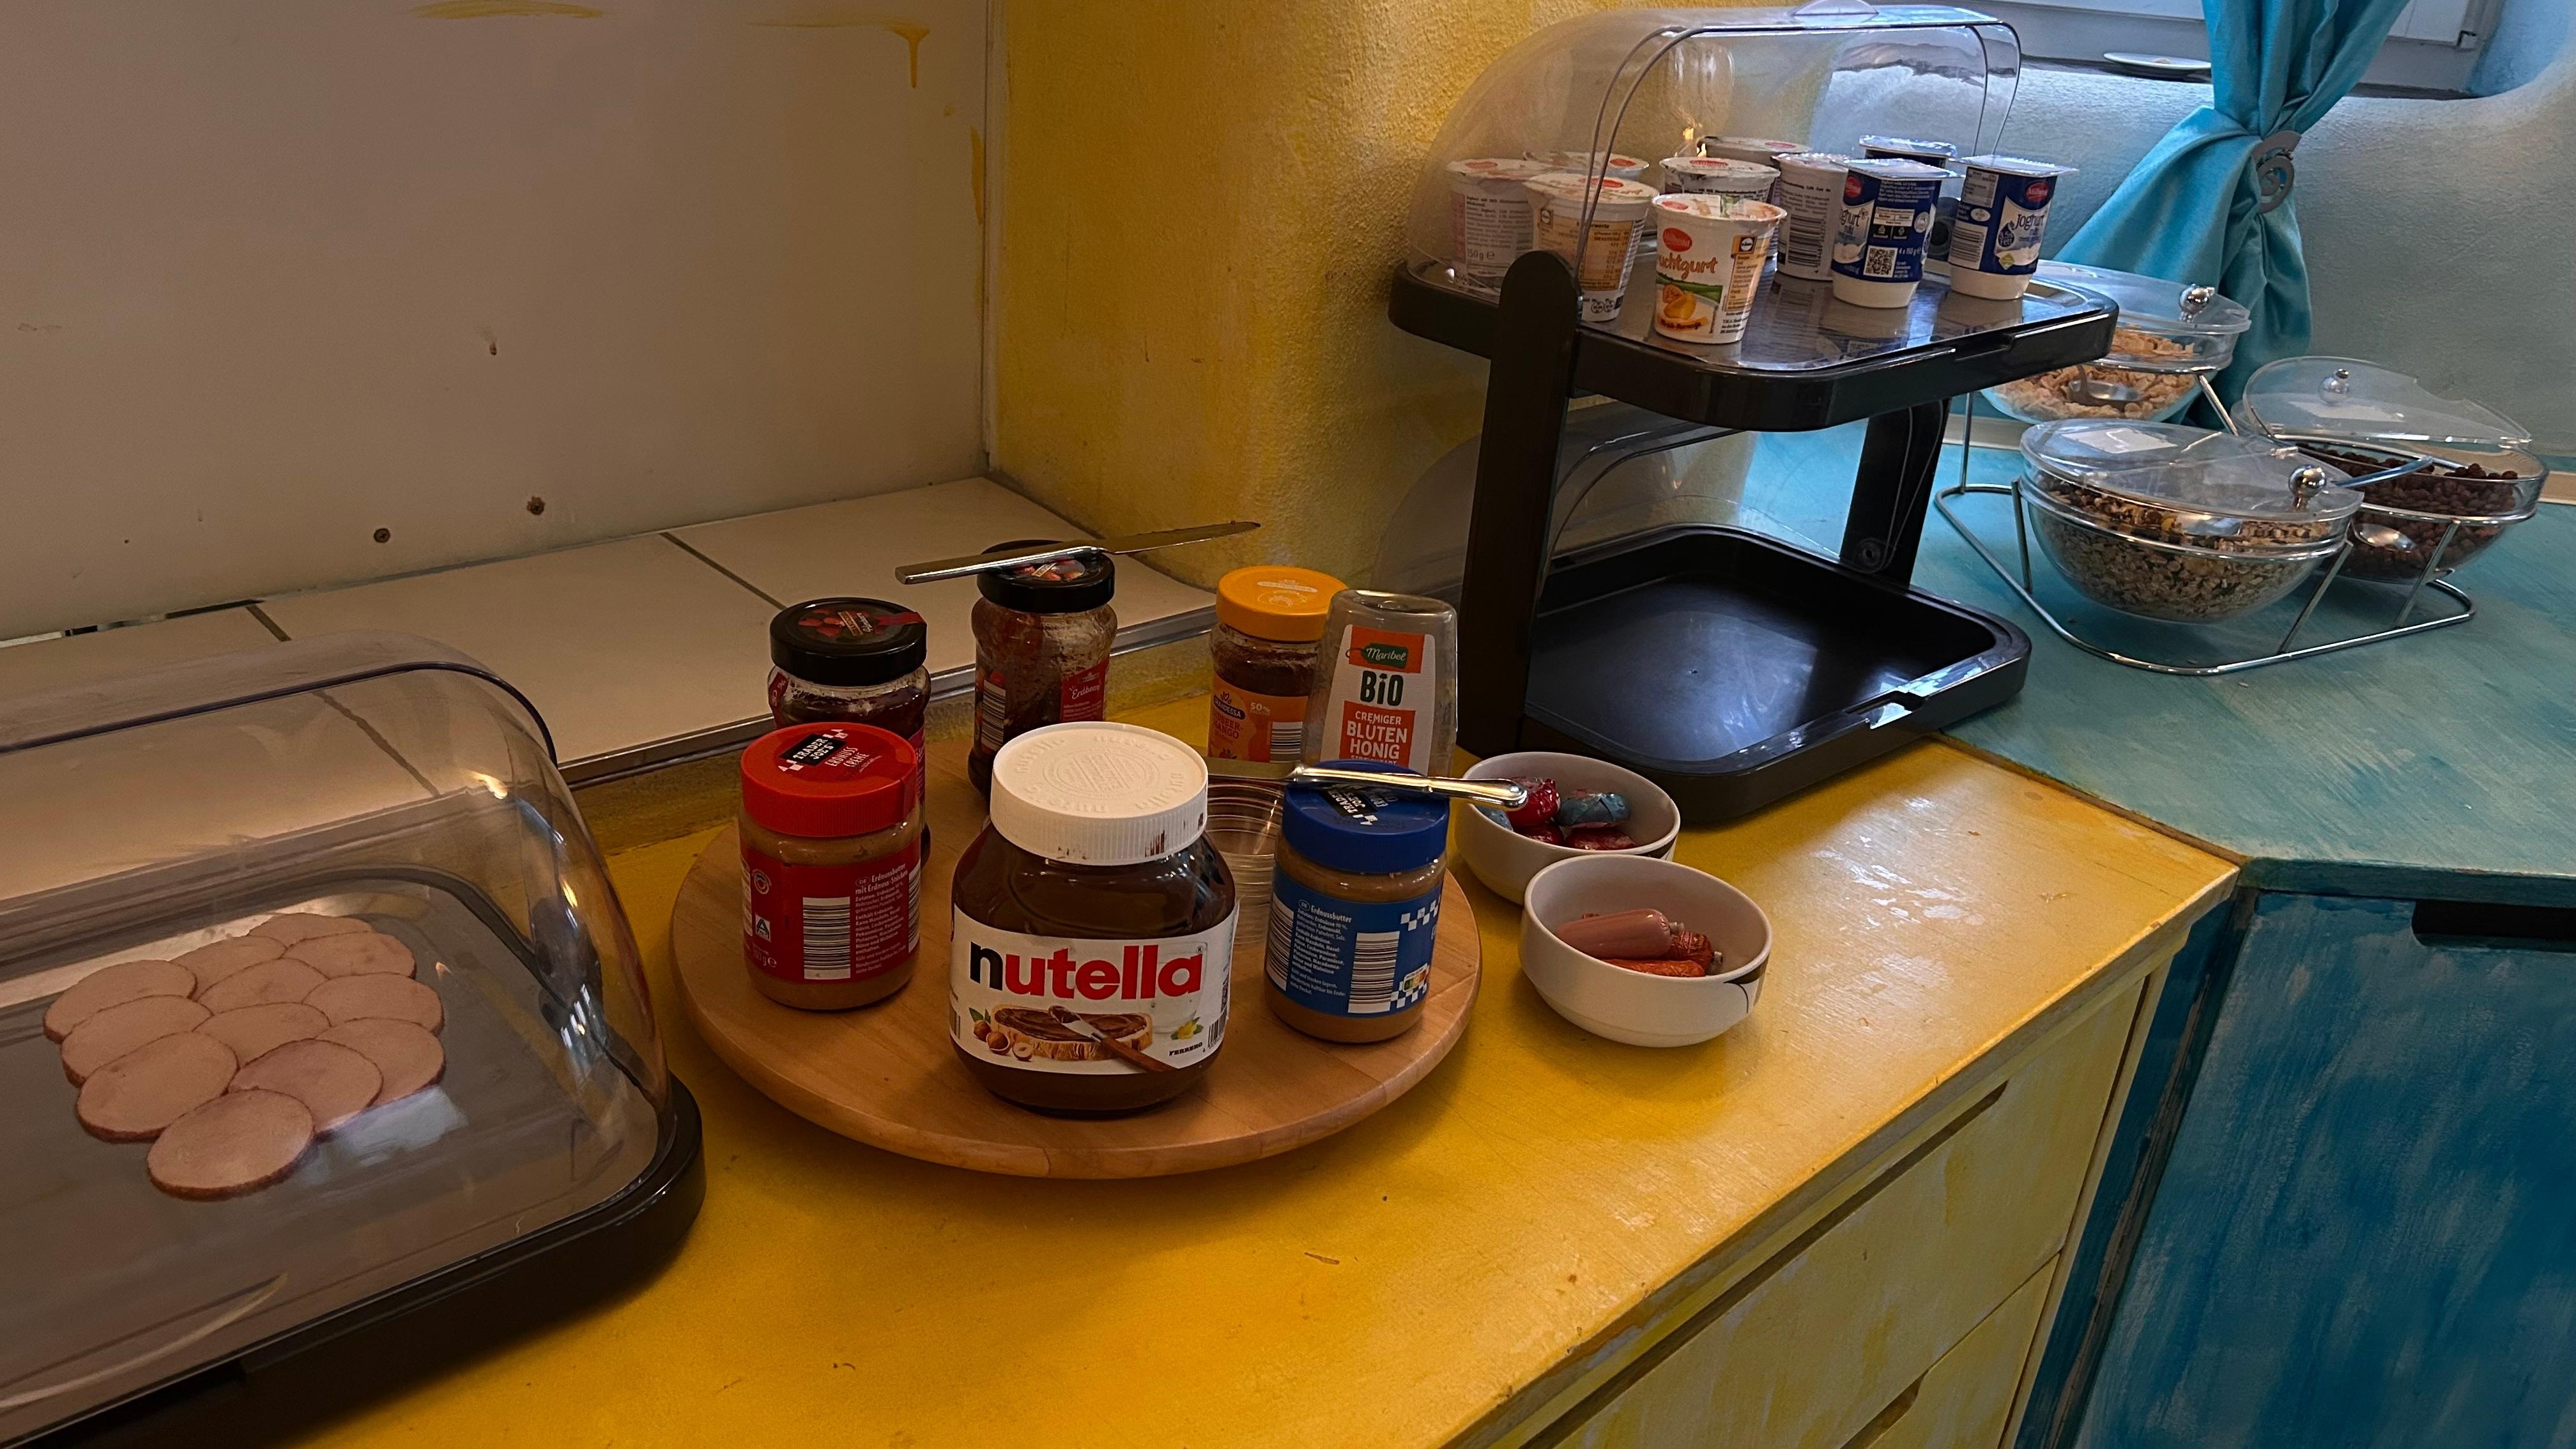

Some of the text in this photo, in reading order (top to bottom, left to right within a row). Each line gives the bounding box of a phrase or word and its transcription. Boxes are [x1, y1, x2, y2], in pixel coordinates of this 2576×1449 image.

[2015, 213, 2045, 231] Joghurt
[1366, 647, 1406, 661] Maribel
[1355, 710, 1402, 726] CREMIGER
[1347, 719, 1407, 744] BLÜTEN
[792, 738, 829, 760] TRADER
[824, 746, 858, 767] ERDNUSS
[1349, 738, 1400, 760] HONIG
[843, 753, 870, 767] CREME
[855, 886, 867, 895] mit
[1310, 905, 1352, 923] Erdnussbutter
[970, 940, 1204, 1001] nutella
[1169, 1041, 1203, 1057] FERRERO
